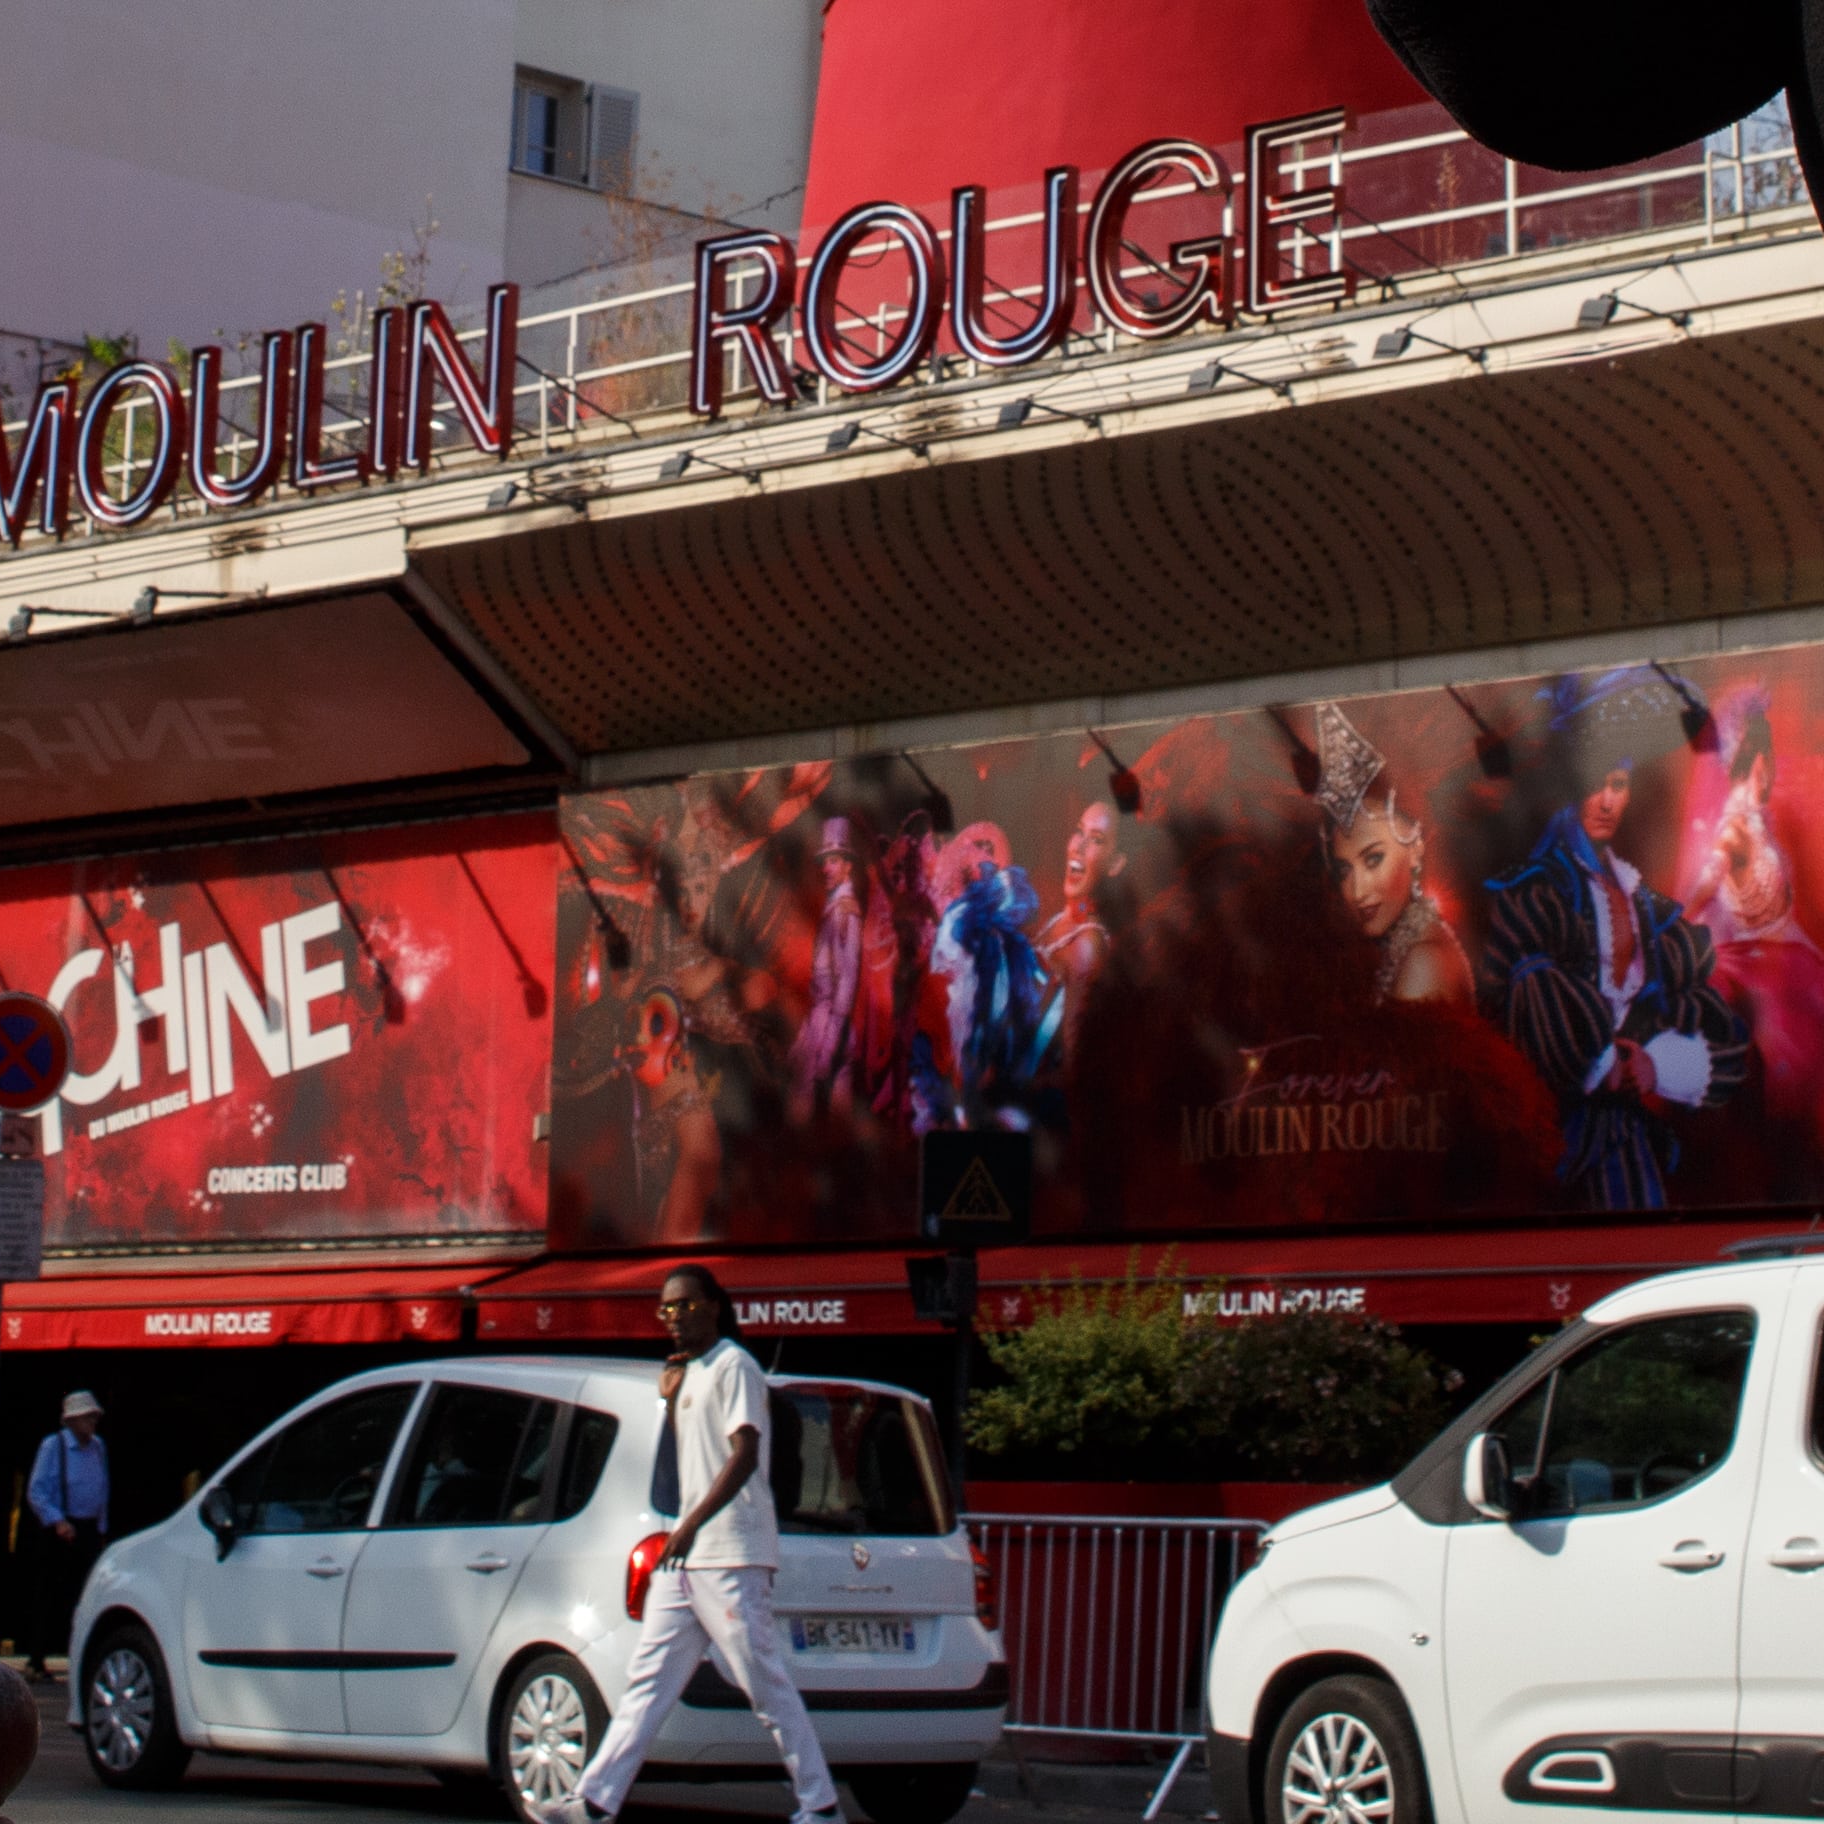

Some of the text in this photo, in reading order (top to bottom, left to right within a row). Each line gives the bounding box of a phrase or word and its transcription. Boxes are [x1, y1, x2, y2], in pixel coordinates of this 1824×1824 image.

[690, 105, 1357, 415] ROUGE
[1217, 1034, 1397, 1108] Forever
[1179, 1090, 1450, 1166] MOULIN ROUGE
[207, 1163, 348, 1193] CONCERTS CLUB
[145, 1311, 272, 1335] MOULIN ROUGE
[773, 1299, 846, 1324] ROUGE
